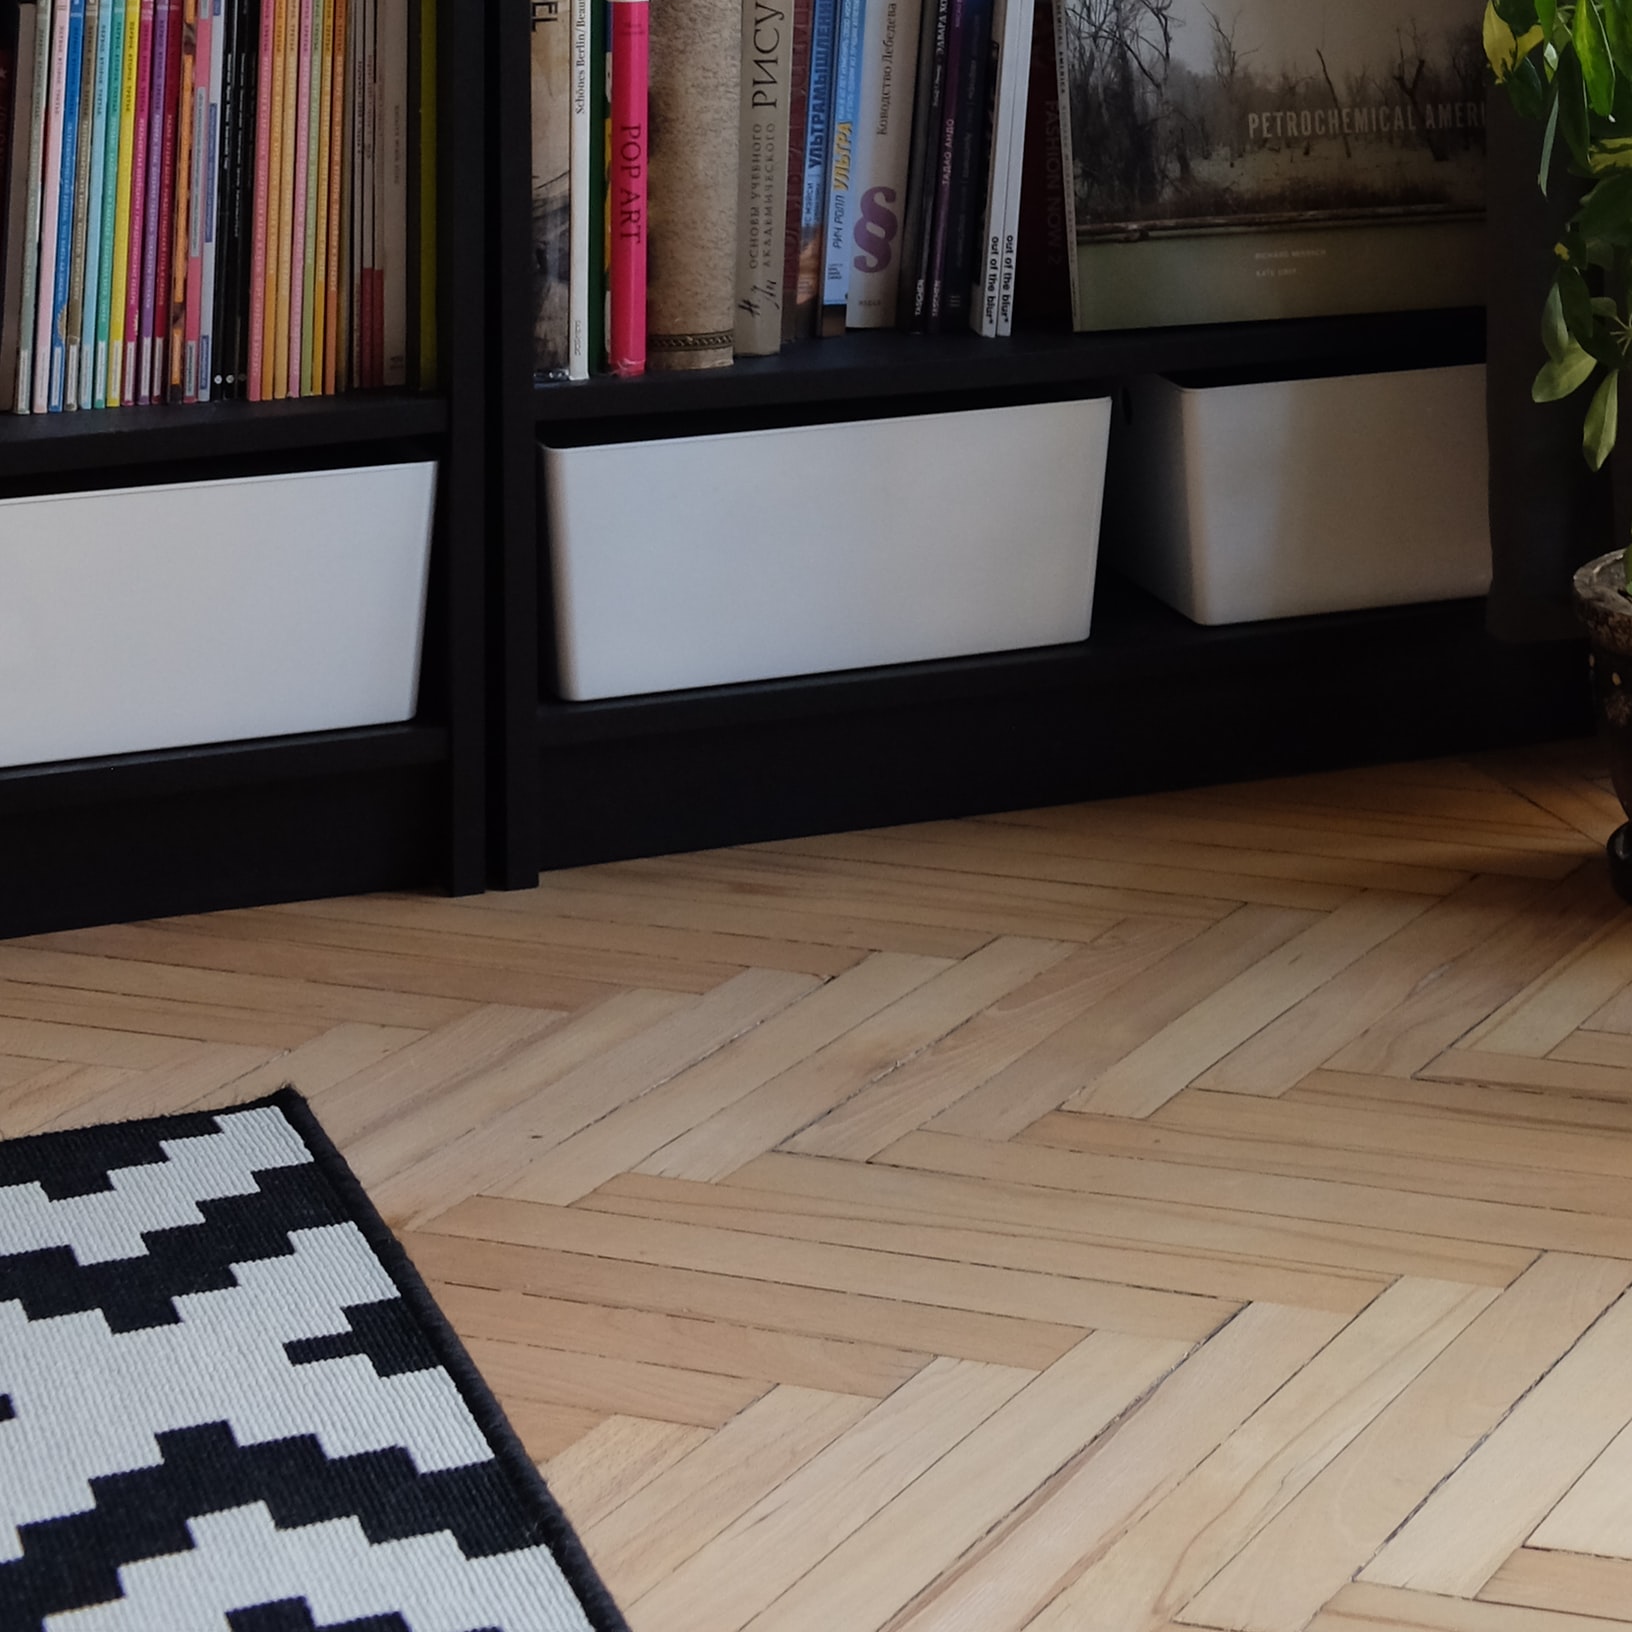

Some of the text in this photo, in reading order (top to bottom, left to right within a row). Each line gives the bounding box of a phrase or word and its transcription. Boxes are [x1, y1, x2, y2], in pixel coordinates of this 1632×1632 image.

[881, 3, 898, 64] Лебедева
[934, 14, 948, 55] ЭДВАРД
[575, 70, 586, 114] Schönes
[876, 66, 893, 136] Ководство
[1248, 97, 1486, 139] PETROCHEMICAL AMERI
[833, 121, 853, 192] УЛЬТРА
[942, 119, 954, 185] ТАДАО АНДО
[619, 123, 643, 245] POP ART
[1044, 100, 1062, 247] FASHION NOW
[749, 123, 762, 269] ОСНОВЫ УЧЕБНОГО
[763, 122, 775, 268] АКАДЕМИЧЕСКОГО
[834, 194, 845, 224] РОЛЛ
[832, 227, 843, 249] РИЧ
[990, 236, 999, 254] out
[1003, 235, 1013, 253] out
[986, 272, 997, 291] the
[987, 258, 998, 270] of
[1001, 257, 1012, 270] of
[1001, 270, 1012, 290] the
[914, 279, 924, 316] TASCHEN
